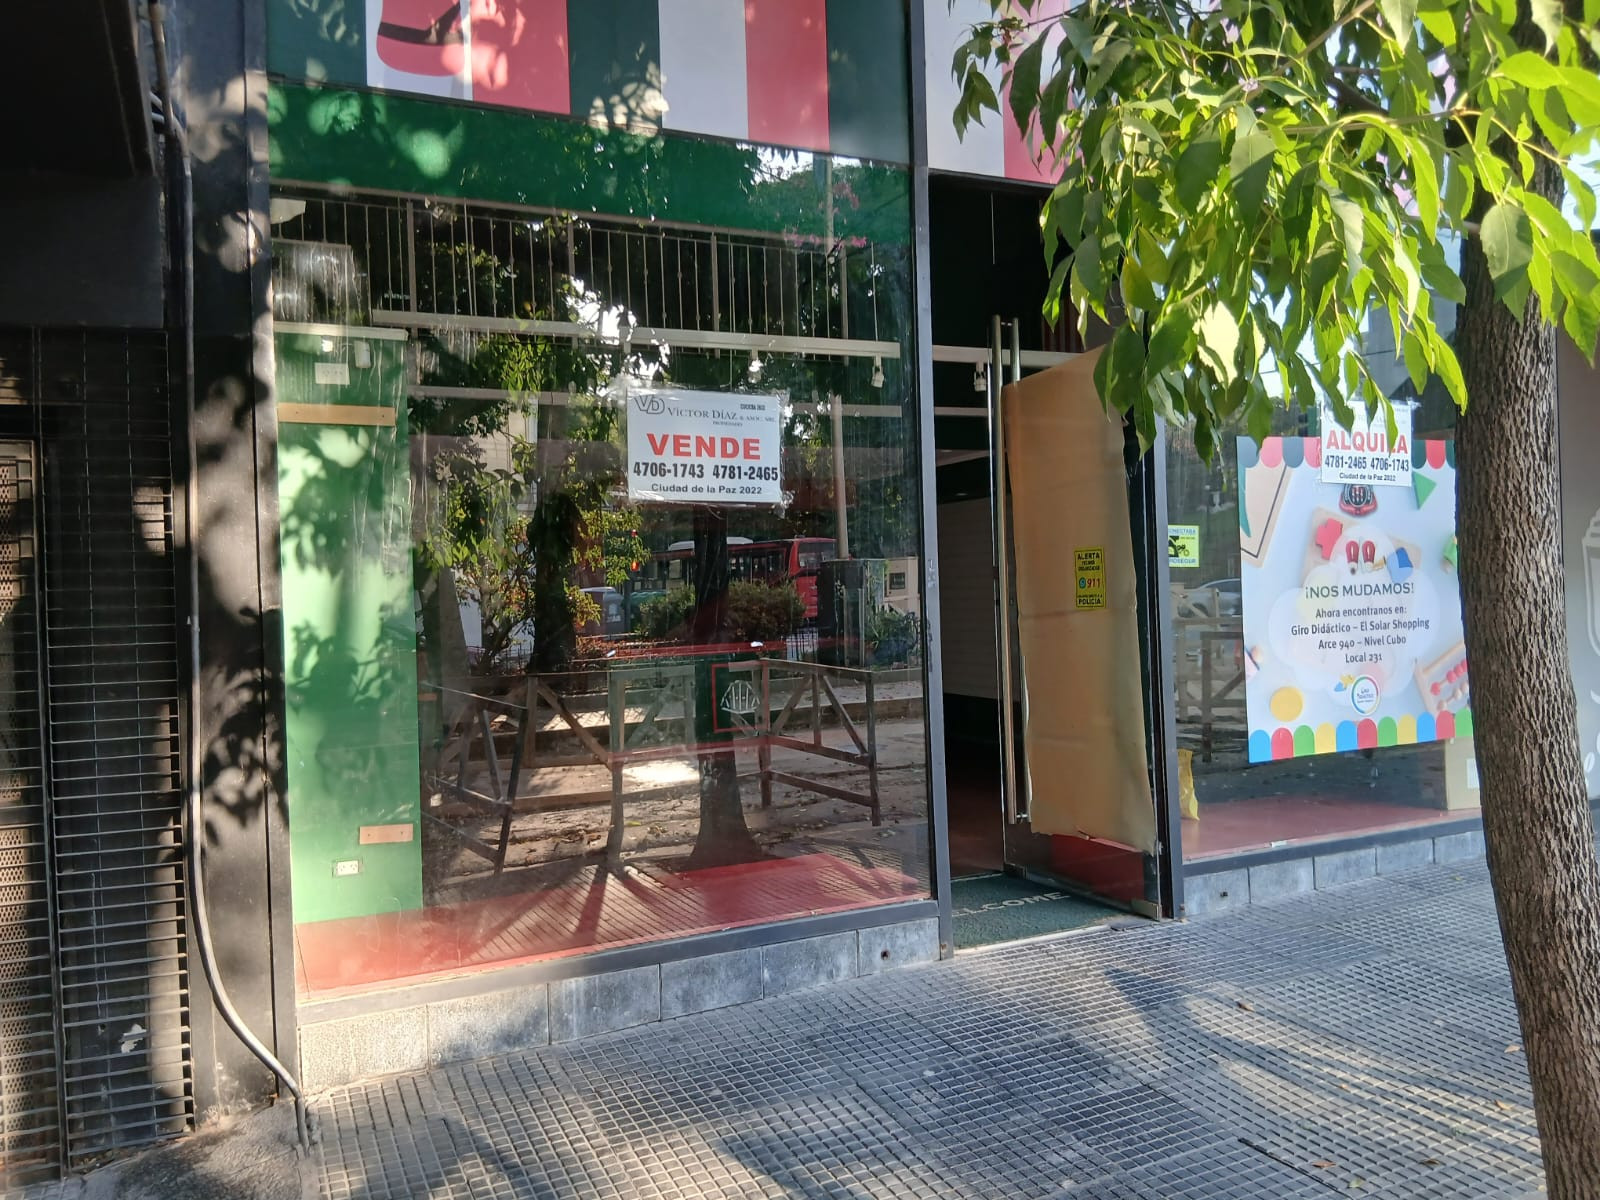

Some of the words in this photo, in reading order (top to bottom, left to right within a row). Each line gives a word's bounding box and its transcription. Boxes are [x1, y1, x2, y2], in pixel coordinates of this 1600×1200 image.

[647, 433, 761, 460] VENDE
[633, 461, 704, 478] 4706-1743
[712, 464, 779, 481] 4781-2465
[1325, 455, 1367, 469] 4781-2465
[1370, 458, 1409, 472] 4706-1743
[651, 483, 688, 493] Ciudad
[691, 485, 704, 493] de
[707, 485, 716, 493] la
[719, 485, 736, 494] Paz
[739, 486, 762, 494] 2022
[1078, 552, 1100, 560] ALERTA
[1087, 578, 1100, 588] 911
[1305, 585, 1339, 599] ¡NOS
[1343, 582, 1415, 597] MUDAMOS!
[1316, 608, 1340, 618] Ahora
[1343, 606, 1392, 617] encontranos
[1394, 606, 1407, 614] en:
[1291, 625, 1309, 635] Giro
[1311, 623, 1351, 634] Didáctico
[1360, 621, 1367, 631] El
[1370, 620, 1391, 631] Solar
[1393, 618, 1430, 630] Shopping
[1318, 640, 1337, 650] Arce
[1339, 640, 1355, 650] 940
[1364, 636, 1385, 646] Nivel
[1386, 635, 1406, 645] Cubo
[1345, 652, 1366, 663] Local
[1368, 653, 1382, 663] 231
